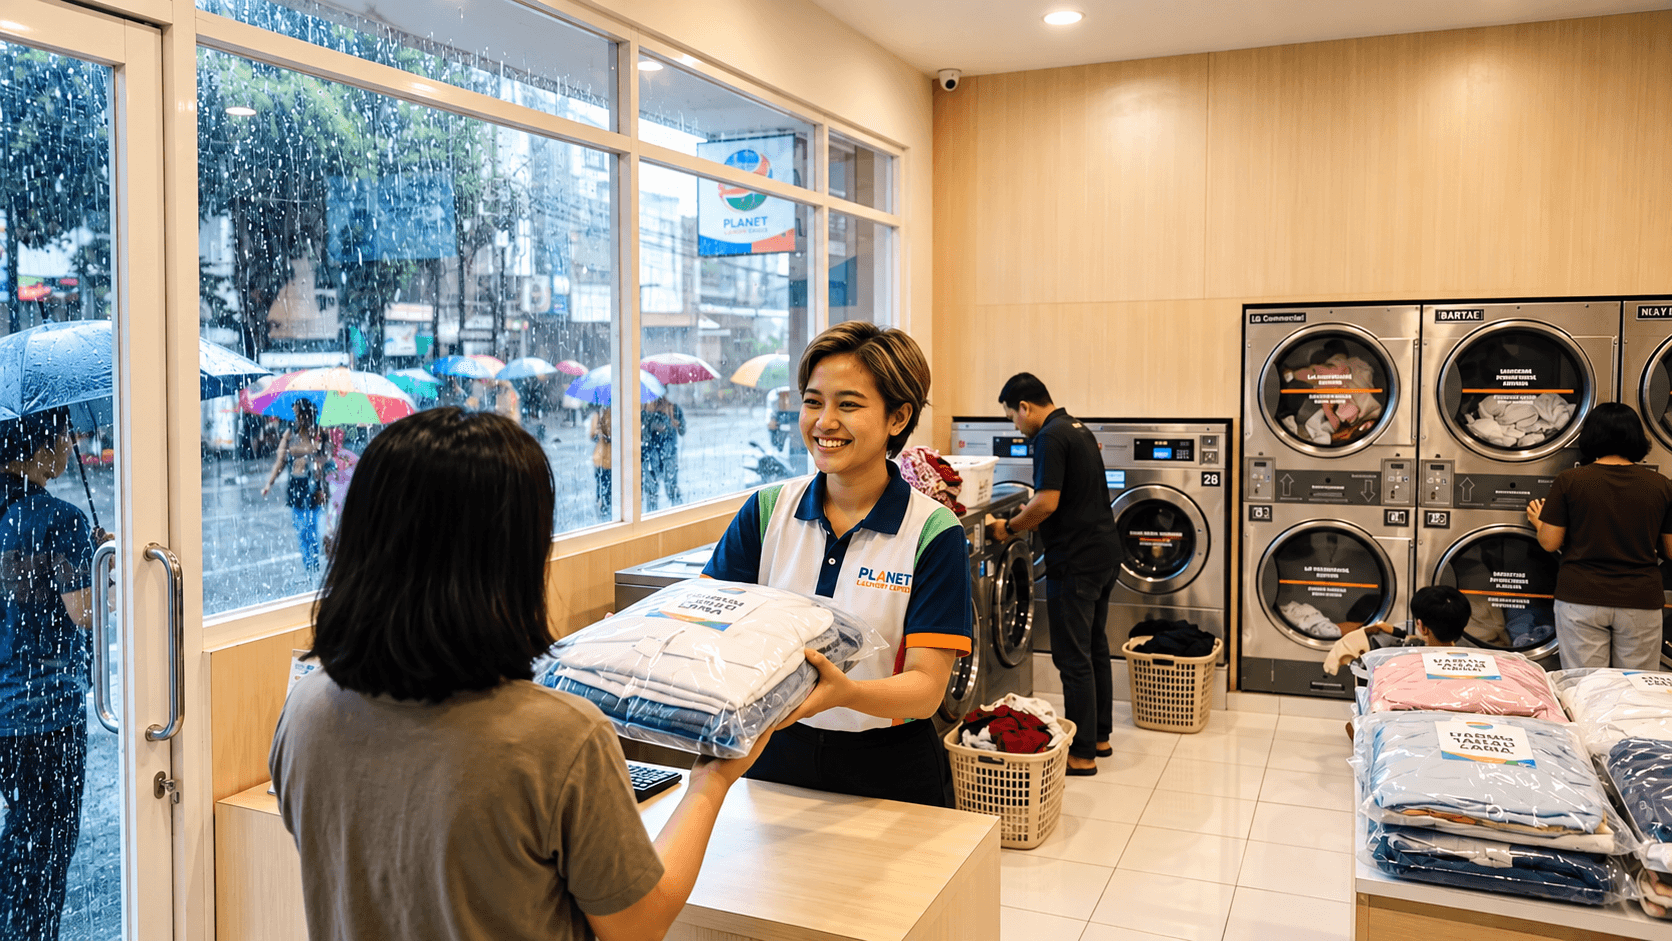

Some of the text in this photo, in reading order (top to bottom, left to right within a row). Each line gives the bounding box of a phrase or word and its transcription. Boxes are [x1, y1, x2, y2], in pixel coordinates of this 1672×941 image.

[723, 216, 768, 228] PLANET
[1203, 474, 1218, 485] 28
[858, 566, 912, 586] PLANET
